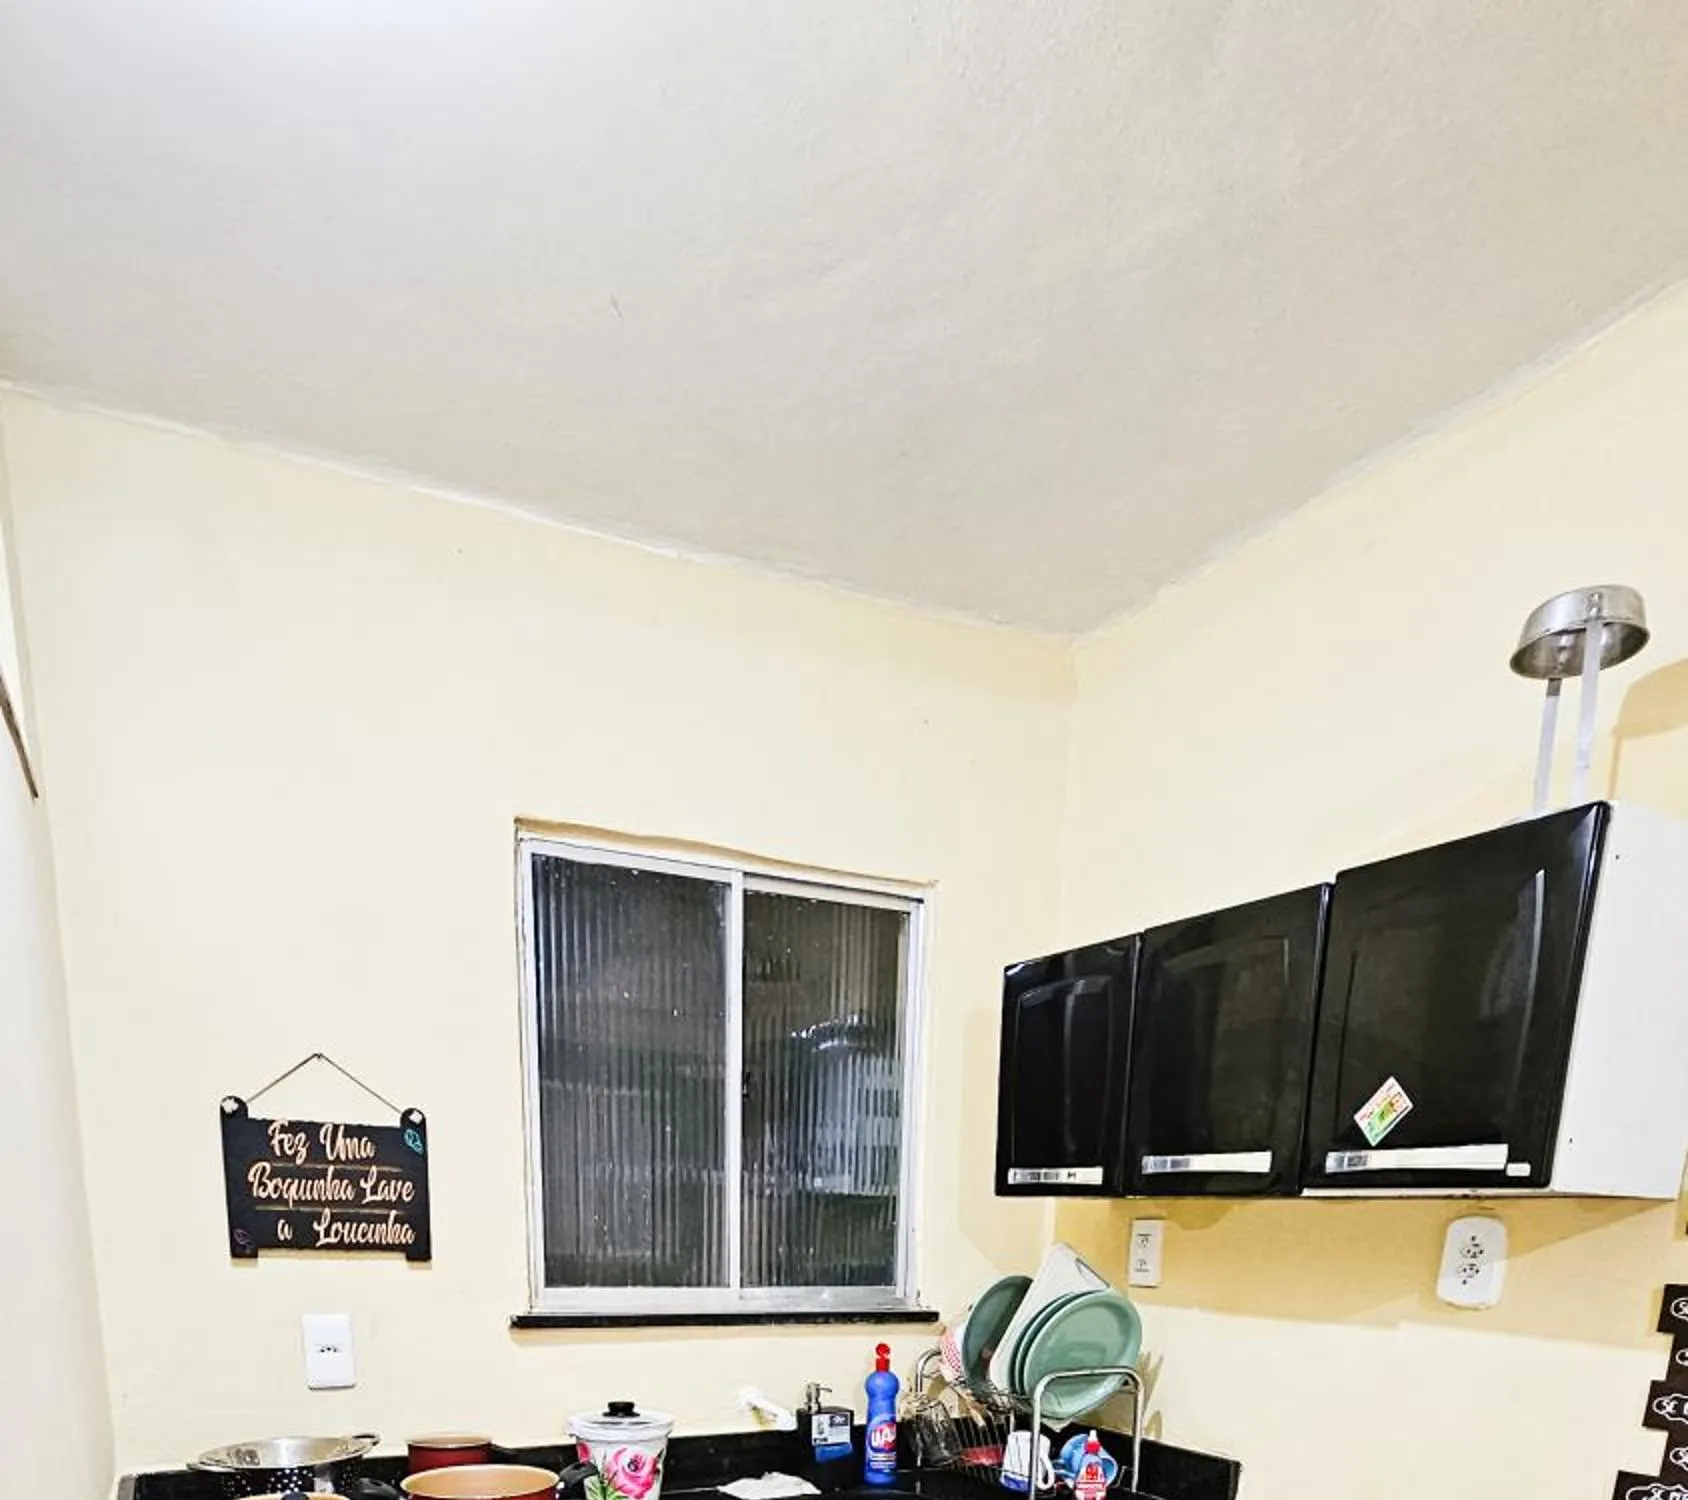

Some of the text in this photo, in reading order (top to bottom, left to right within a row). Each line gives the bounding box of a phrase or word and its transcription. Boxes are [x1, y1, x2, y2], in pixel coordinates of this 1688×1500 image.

[267, 1120, 310, 1165] Fez
[247, 1161, 415, 1209] Boquinha Lave
[277, 1207, 416, 1248] a Loucinha
